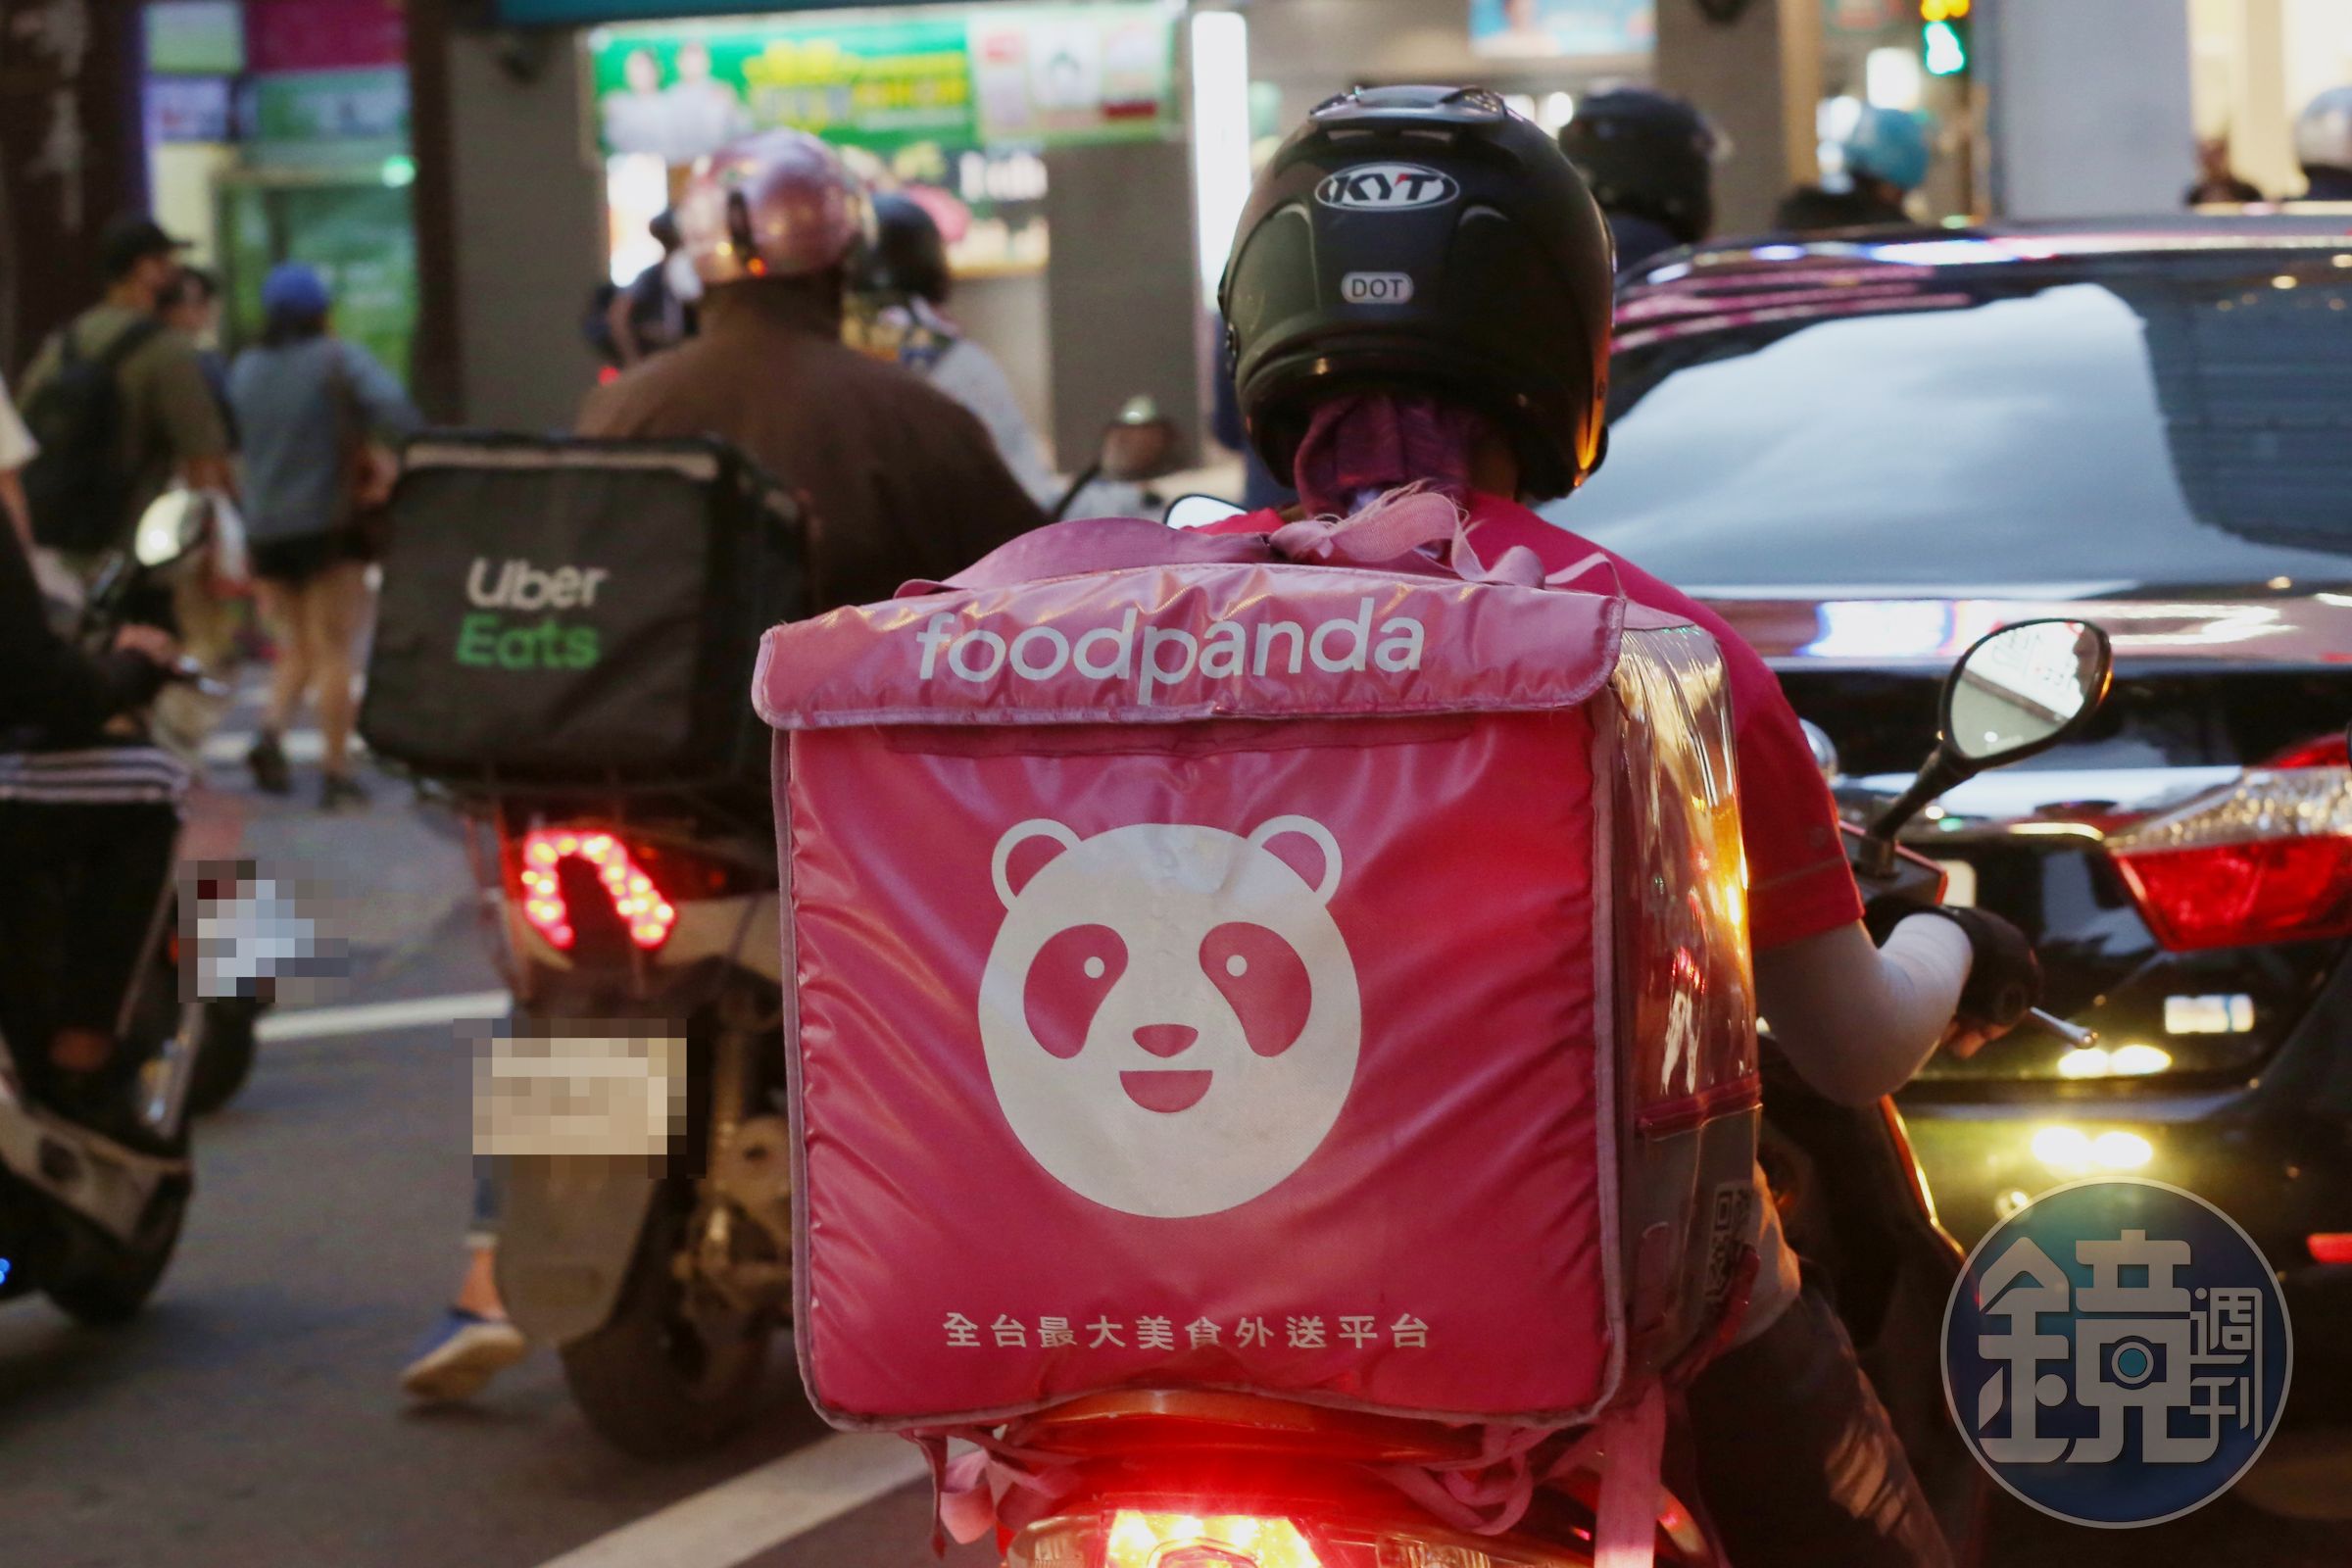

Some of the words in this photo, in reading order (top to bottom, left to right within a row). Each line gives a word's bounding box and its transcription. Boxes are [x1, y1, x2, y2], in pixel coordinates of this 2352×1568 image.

[1330, 172, 1442, 204] KYT
[1351, 278, 1403, 298] DOT
[466, 558, 610, 612] Uber
[457, 612, 600, 670] Eats
[916, 597, 1425, 706] foodpanda
[942, 1312, 1430, 1351] 全台最大美食外送平台
